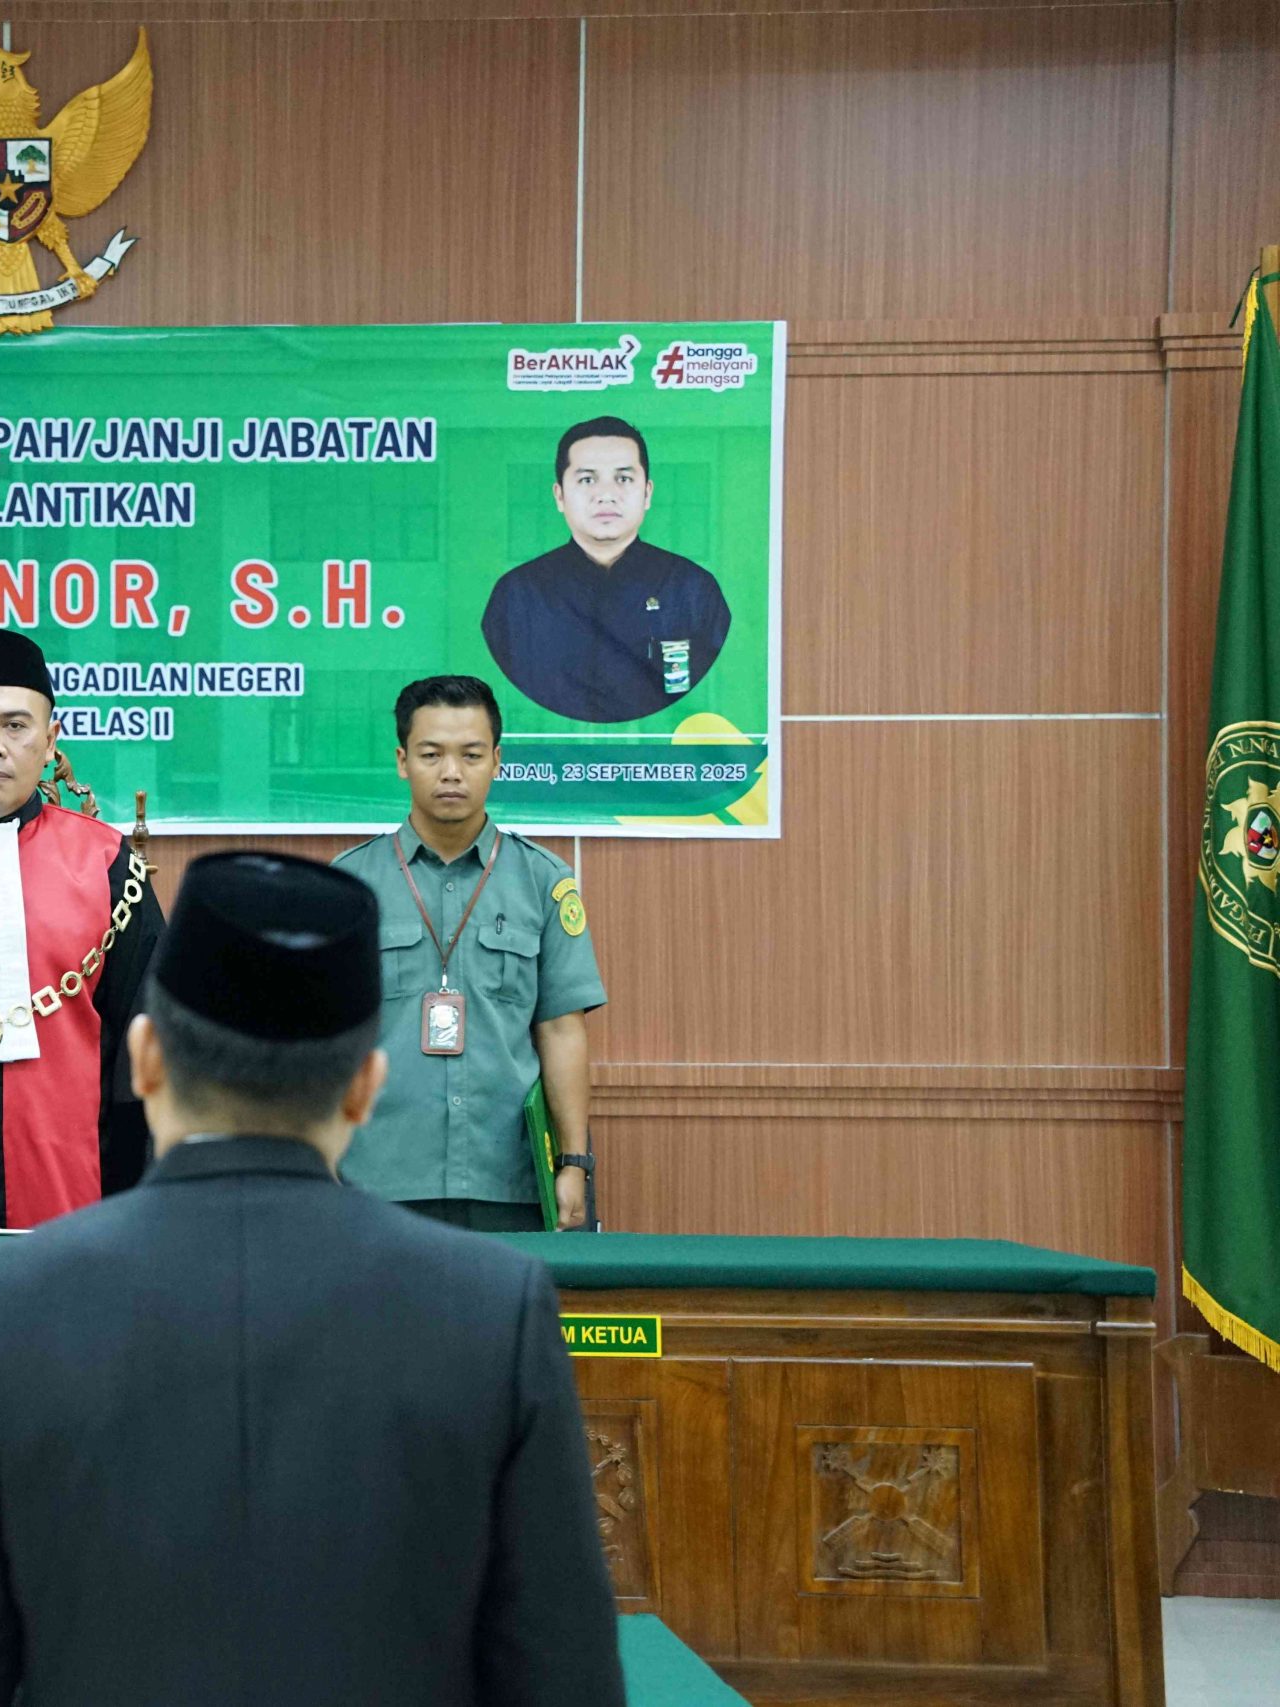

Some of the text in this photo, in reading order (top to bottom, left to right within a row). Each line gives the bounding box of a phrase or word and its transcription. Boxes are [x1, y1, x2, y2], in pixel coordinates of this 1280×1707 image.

[513, 354, 628, 371] BerAKHLAK
[686, 345, 743, 361] bangga
[686, 358, 754, 375] melayani
[686, 373, 740, 388] bangsa
[231, 420, 434, 459] JABATAN
[233, 562, 402, 626] S.H.
[47, 665, 188, 693] NGADILAN
[197, 665, 302, 693] NEGERI
[53, 710, 146, 737] KELAS
[153, 710, 171, 737] II
[497, 763, 747, 784] NDAU, 23 SEPTEMBER 2025
[581, 1326, 648, 1344] KETUA
